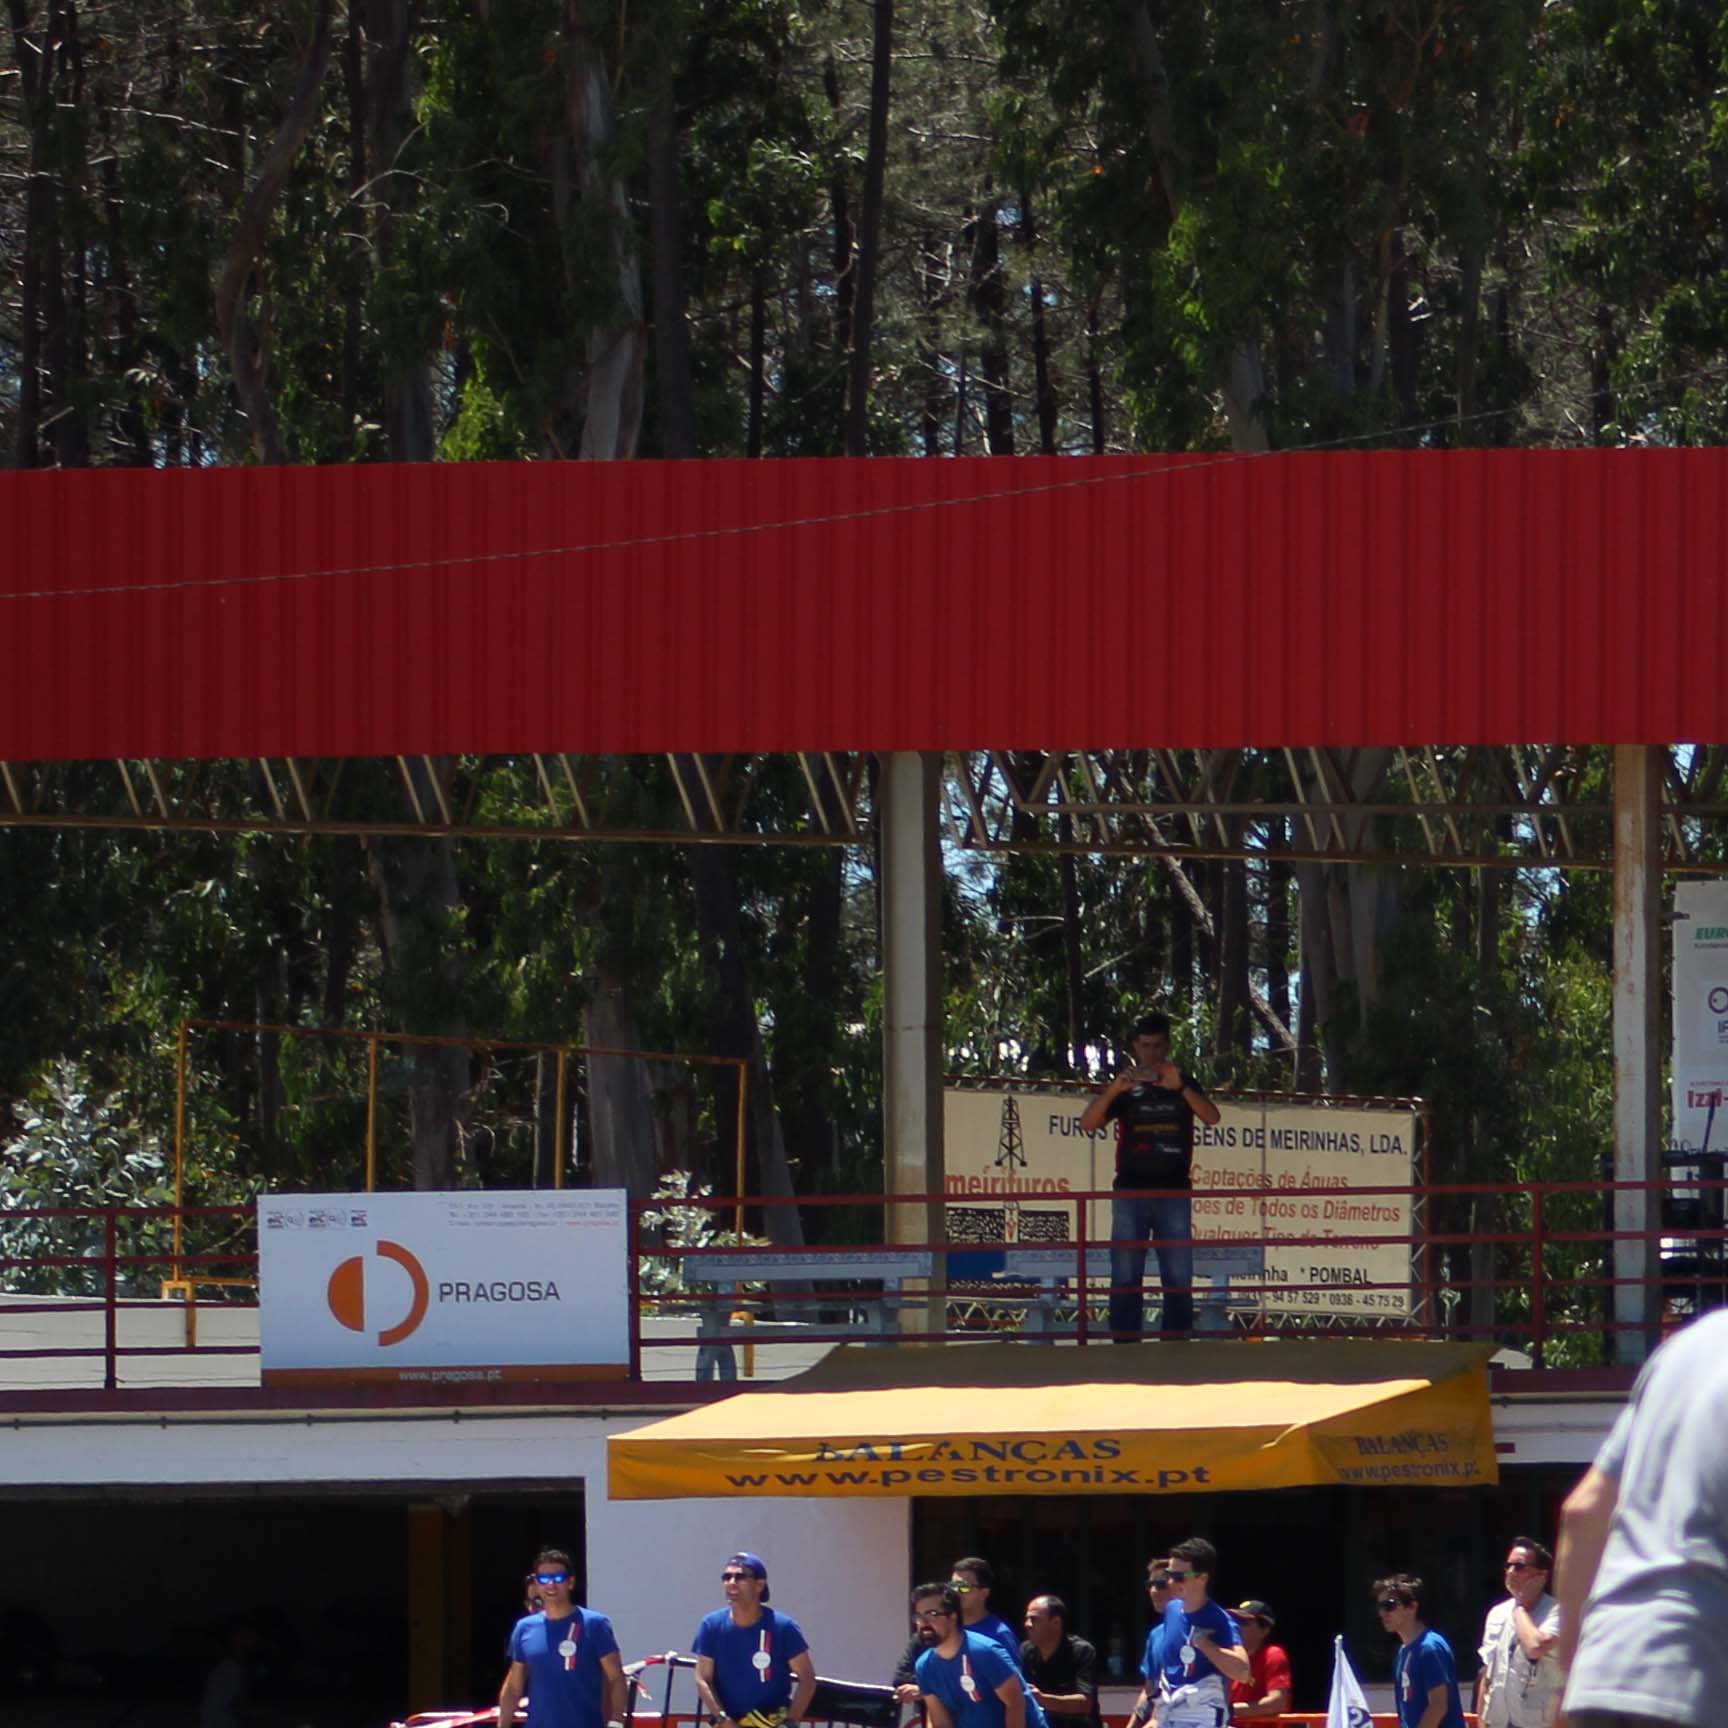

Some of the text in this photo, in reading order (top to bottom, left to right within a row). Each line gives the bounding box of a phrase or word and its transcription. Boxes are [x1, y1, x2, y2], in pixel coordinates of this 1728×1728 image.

[1242, 1127, 1266, 1149] DE
[1270, 1128, 1365, 1157] MEIRINHAS,
[1370, 1133, 1408, 1156] LDA.
[1278, 1168, 1296, 1187] de
[1225, 1197, 1245, 1215] de
[1301, 1201, 1318, 1219] os
[1323, 1199, 1400, 1222] Diâmetros
[1310, 1266, 1373, 1285] POMBAL
[438, 1281, 561, 1304] PRAGOSA
[399, 1367, 503, 1386] www.pragosa.pt
[725, 1466, 1212, 1489] www.pestronix.pt
